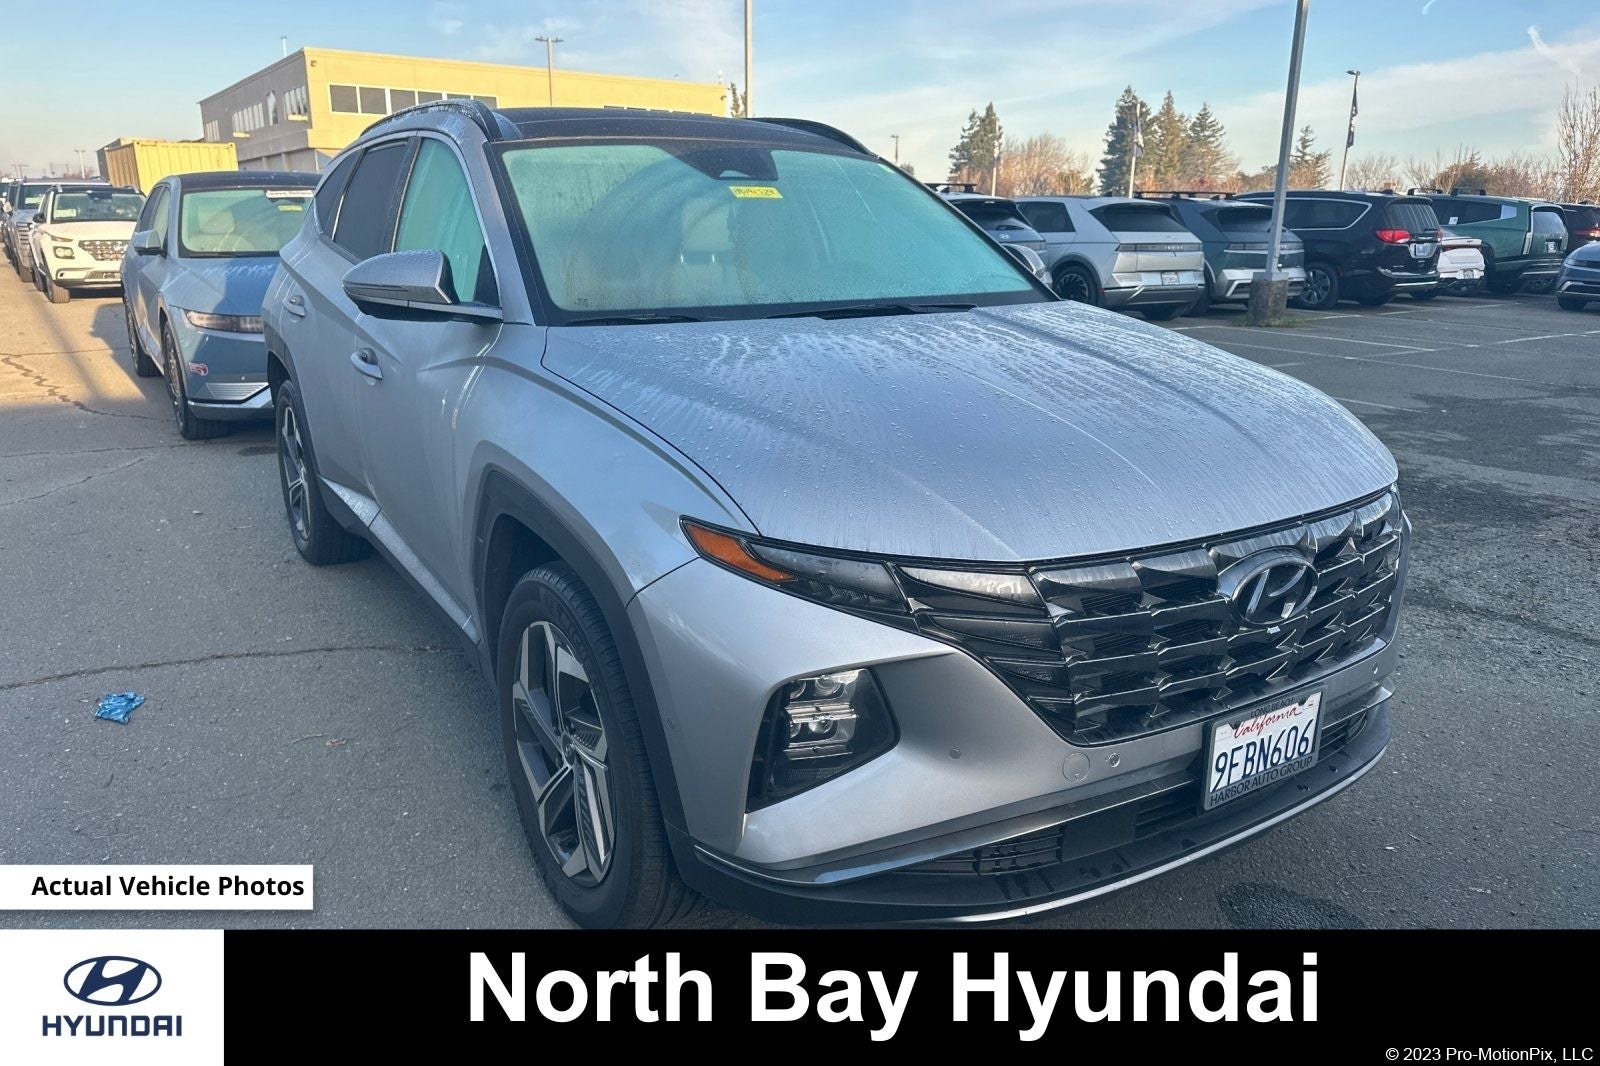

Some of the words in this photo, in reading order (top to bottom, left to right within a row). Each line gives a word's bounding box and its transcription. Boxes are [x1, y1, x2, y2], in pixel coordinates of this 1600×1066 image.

[1234, 708, 1303, 738] California
[1250, 706, 1271, 718] LONG
[1271, 698, 1294, 711] BEACH
[1212, 718, 1314, 793] 9FBN606
[1210, 781, 1251, 807] HARBOR
[1251, 770, 1278, 786] AUTO
[1280, 756, 1313, 776] GROUP
